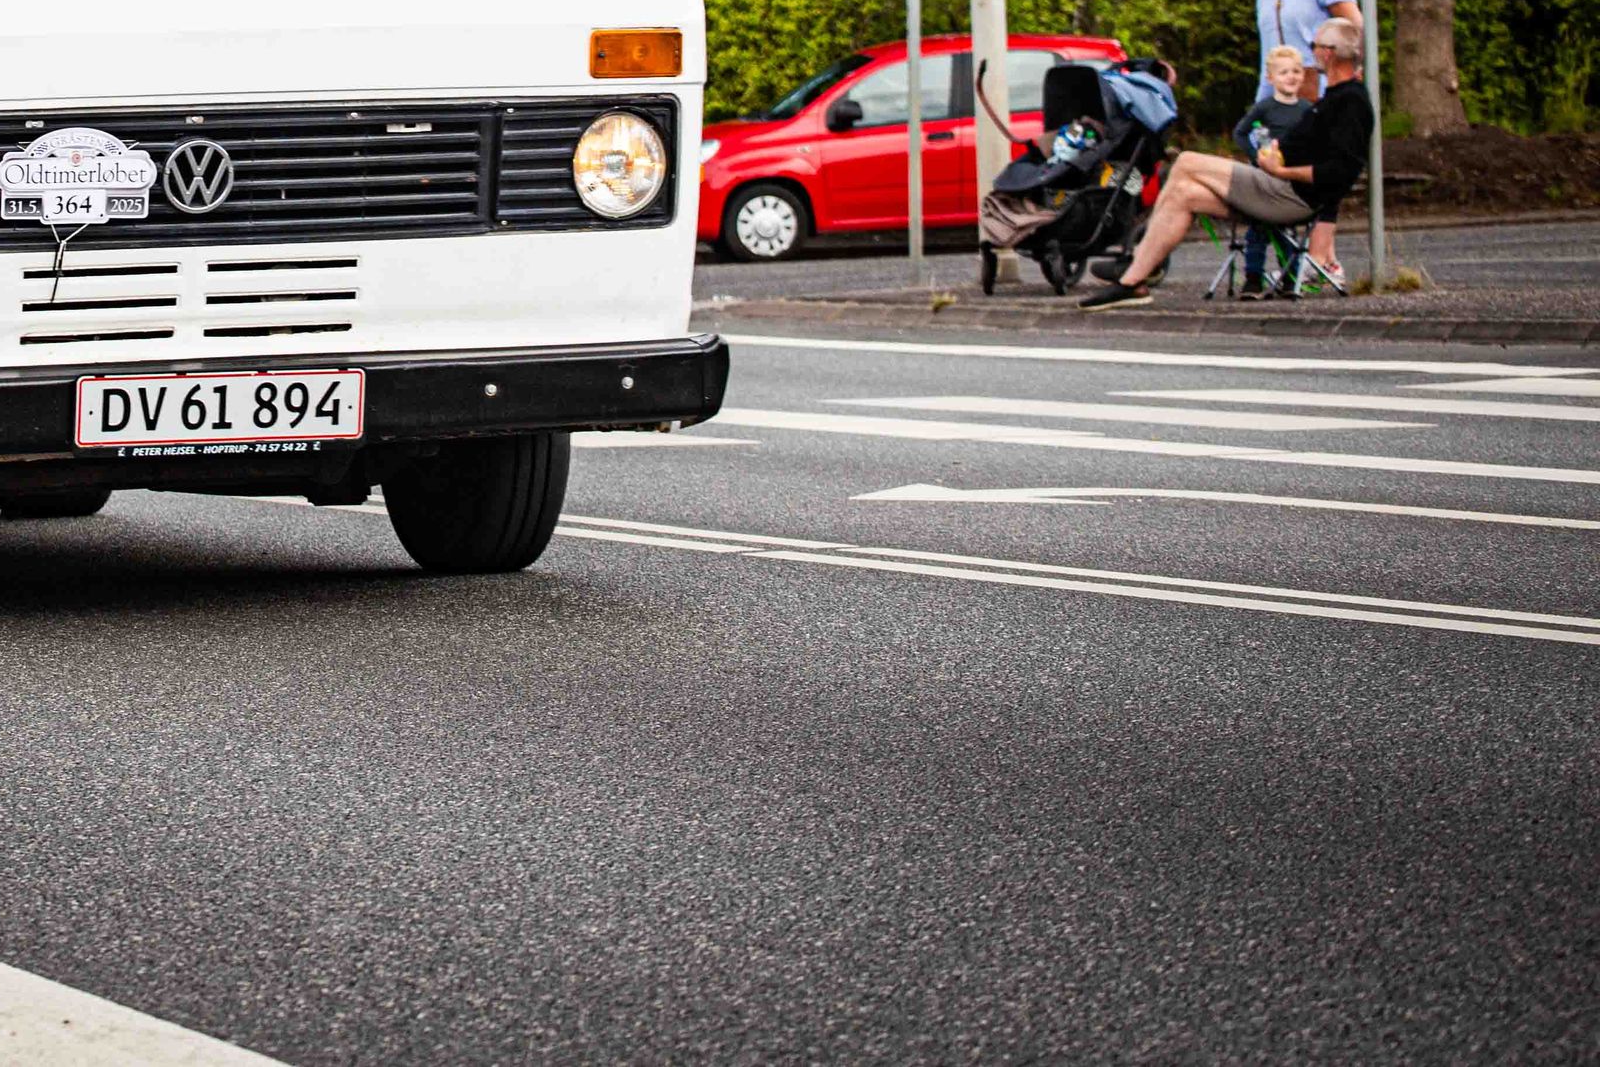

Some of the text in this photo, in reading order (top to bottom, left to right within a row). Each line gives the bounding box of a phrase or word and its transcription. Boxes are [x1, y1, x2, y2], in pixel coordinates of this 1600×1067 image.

[4, 162, 148, 185] Oldtimerløbet
[7, 194, 143, 215] 31.5. 364 2025
[101, 381, 341, 432] DV 61 894
[132, 446, 162, 456] PETER
[203, 444, 249, 455] HOPTRUP
[254, 443, 267, 453] 74
[267, 443, 279, 452] 57
[294, 442, 308, 451] 22
